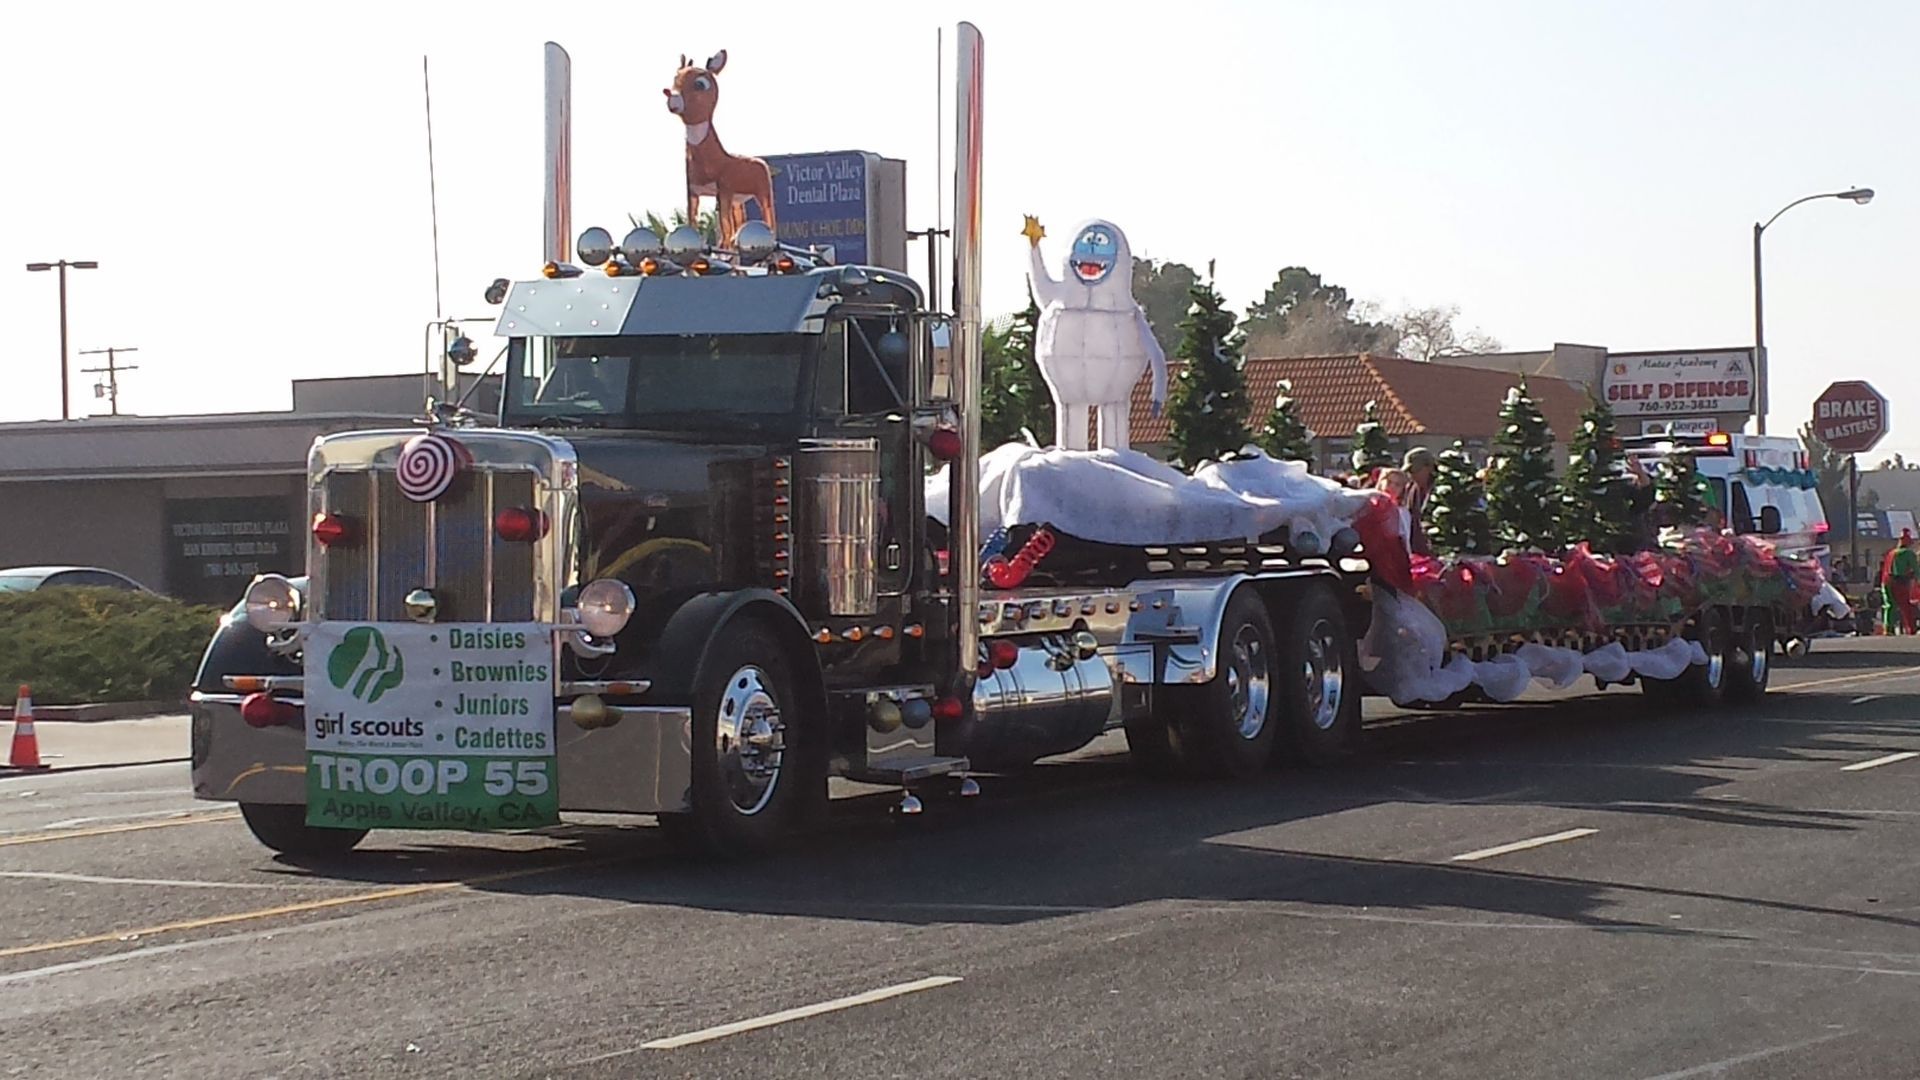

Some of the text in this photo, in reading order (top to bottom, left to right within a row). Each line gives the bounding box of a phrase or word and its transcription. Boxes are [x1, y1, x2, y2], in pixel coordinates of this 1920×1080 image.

[786, 160, 863, 183] Victor Valley
[788, 181, 861, 205] Dental Plaza
[1607, 380, 1749, 401] SELF DEFENSE
[1819, 399, 1878, 418] BRAKE
[1824, 419, 1878, 440] MASTERS
[450, 628, 526, 649] Daisies
[451, 660, 547, 682] Brownies
[453, 693, 529, 716] Juniors
[315, 712, 424, 739] girl scouts
[454, 726, 547, 749] Cadettes
[312, 755, 549, 796] TROOP 55
[322, 798, 545, 824] Apple Valley, CA
